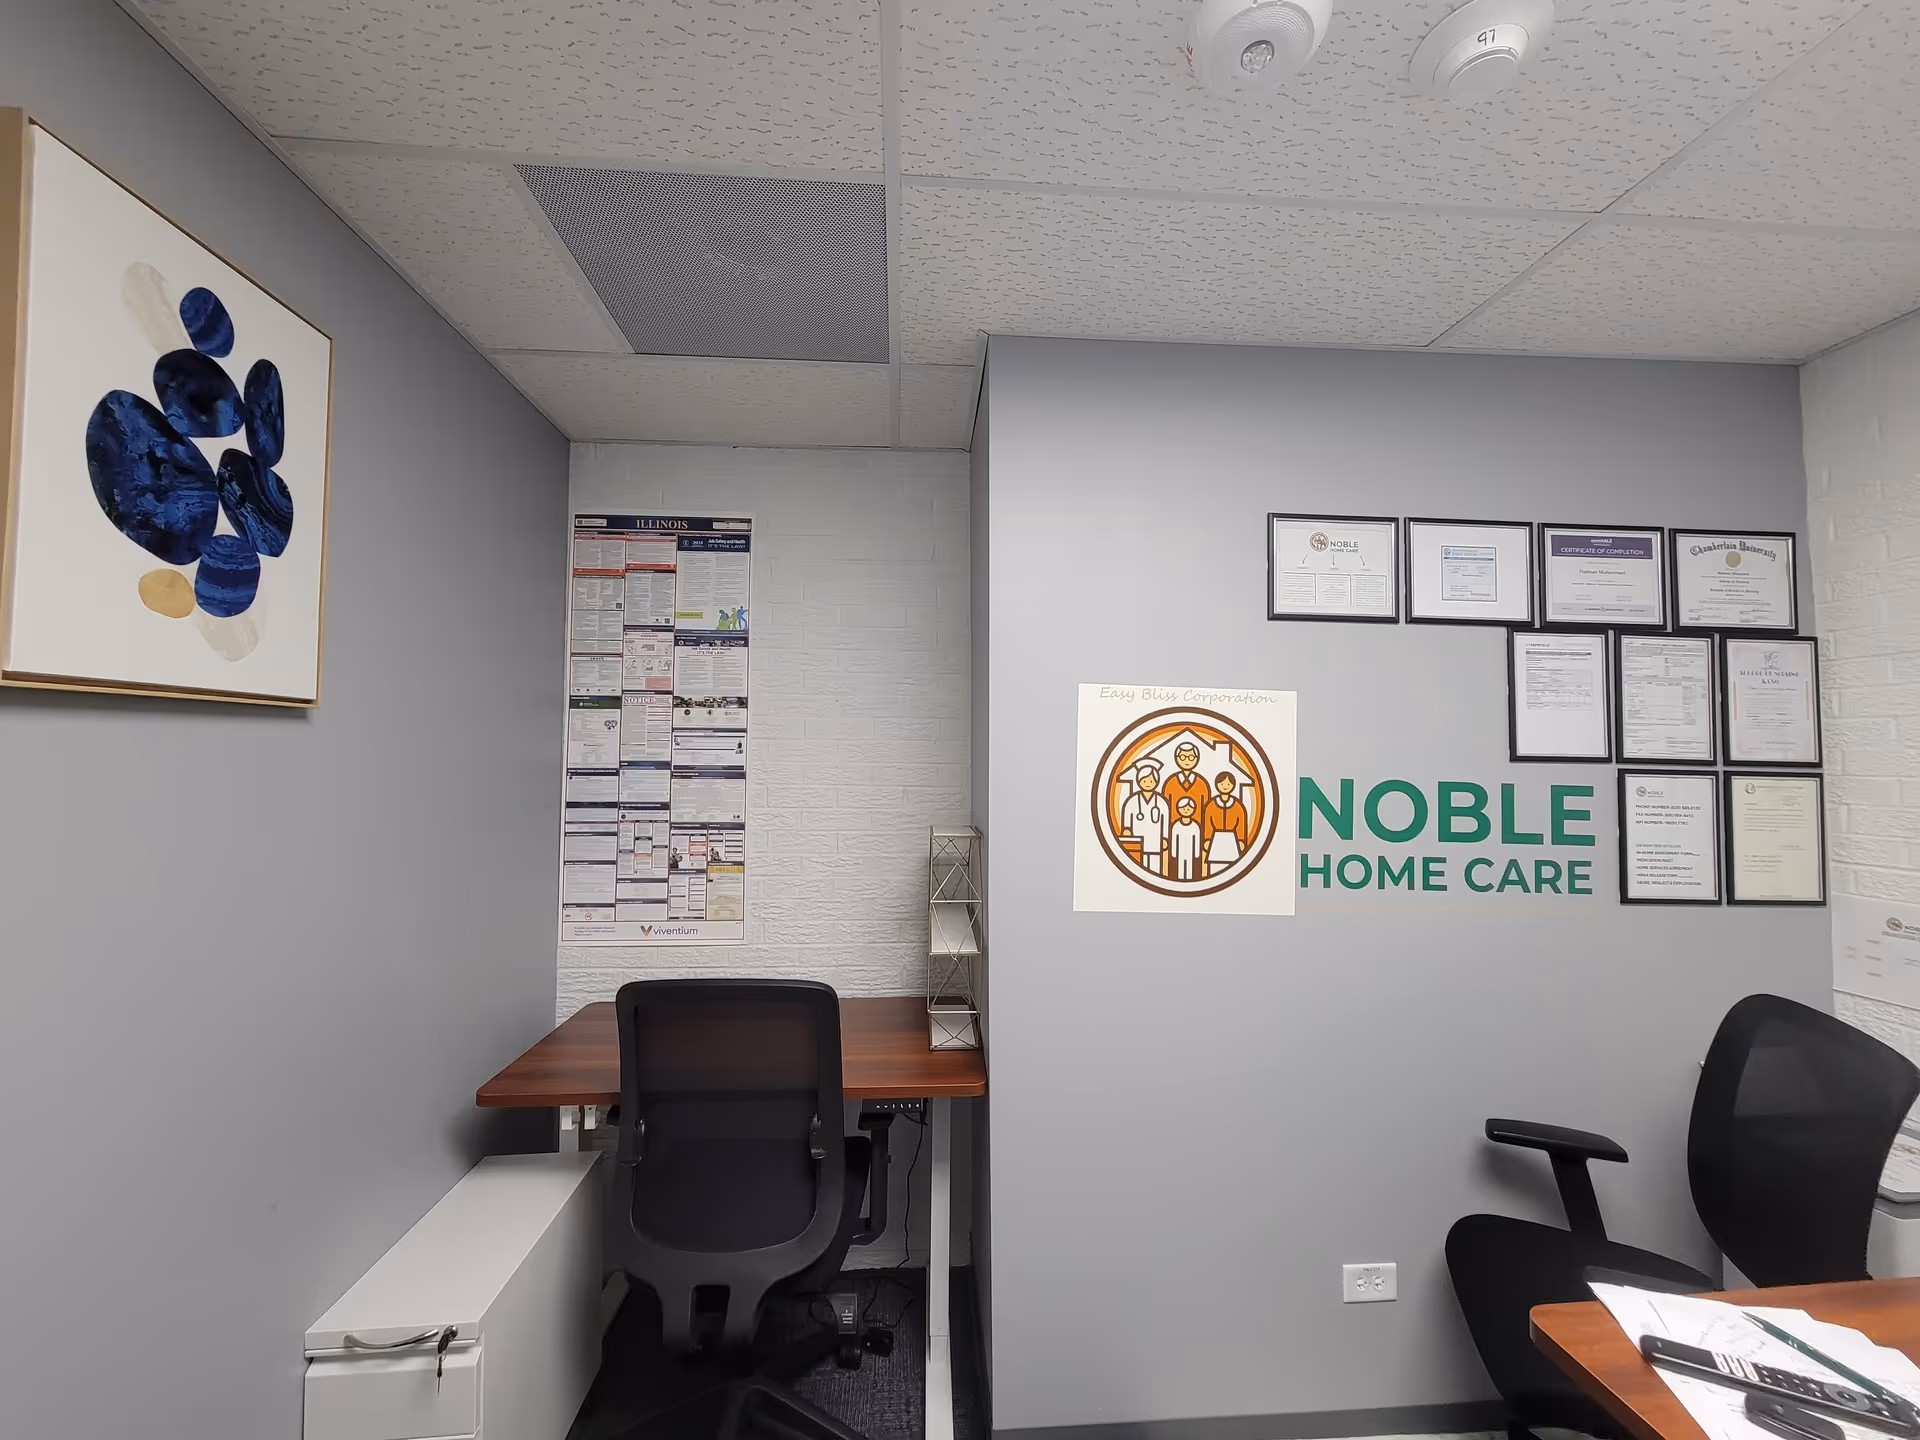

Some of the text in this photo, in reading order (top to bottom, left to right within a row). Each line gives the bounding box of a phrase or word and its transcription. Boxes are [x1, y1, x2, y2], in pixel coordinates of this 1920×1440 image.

[1477, 28, 1496, 46] 97
[636, 519, 688, 529] ILLINOIS
[1329, 540, 1359, 549] NOBLE
[1689, 540, 1777, 561] Chamberlain University
[1100, 687, 1277, 705] Easy Bliss Corporation
[1299, 777, 1596, 846] NOBLE
[1300, 853, 1594, 895] HOME CARE
[653, 926, 698, 935] viventium
